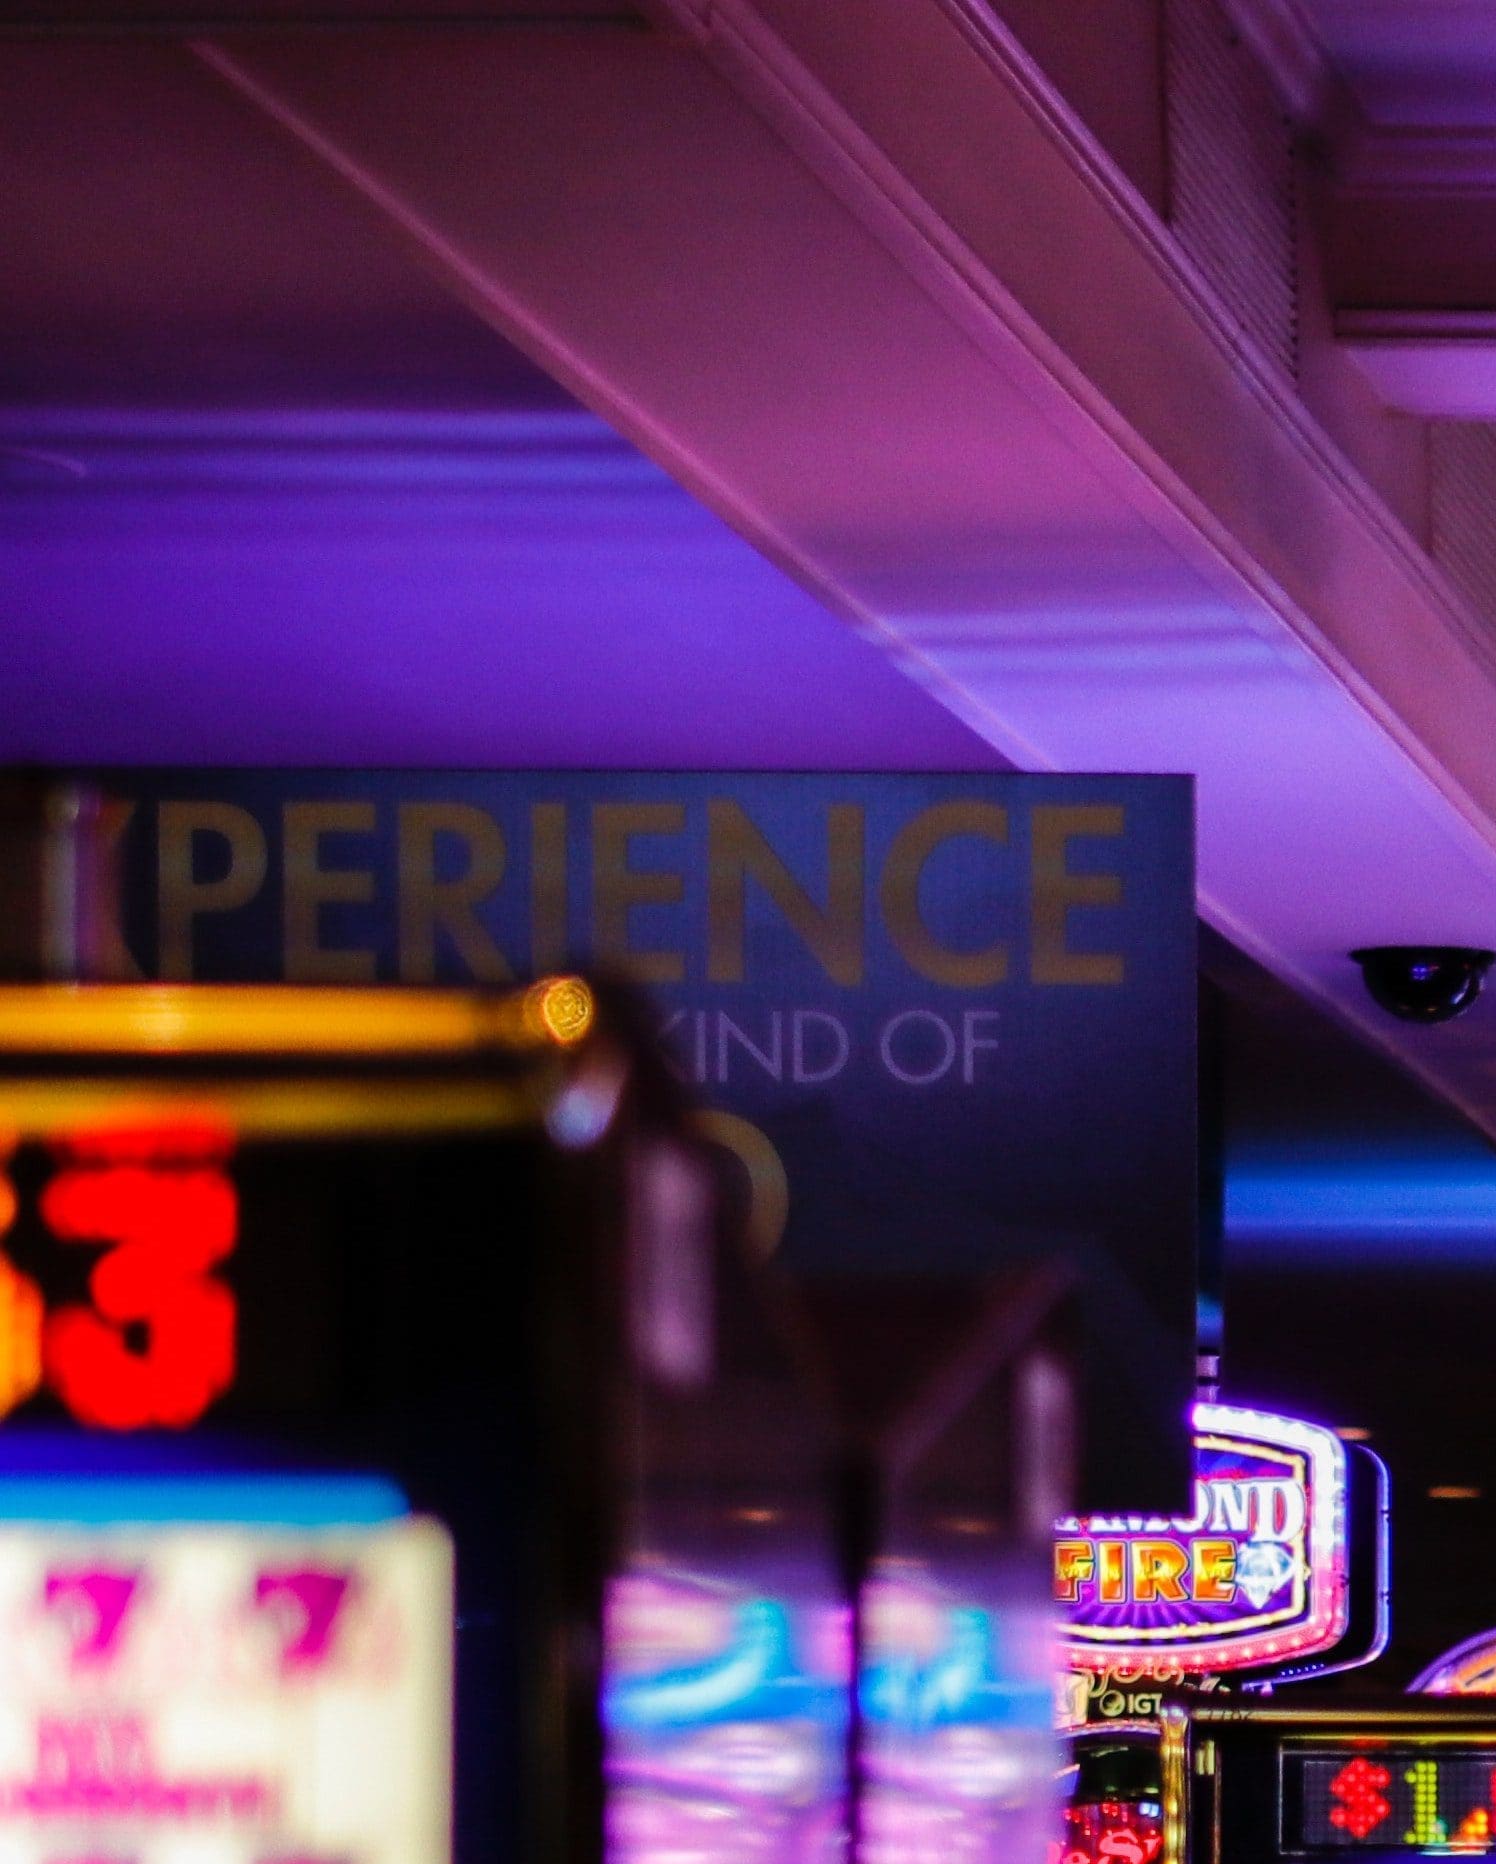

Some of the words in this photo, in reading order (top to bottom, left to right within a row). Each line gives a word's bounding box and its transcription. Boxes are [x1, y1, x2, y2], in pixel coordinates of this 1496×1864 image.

[879, 1010, 1001, 1084] OF
[1053, 1538, 1238, 1603] FIRE
[1127, 1693, 1163, 1714] IGT
